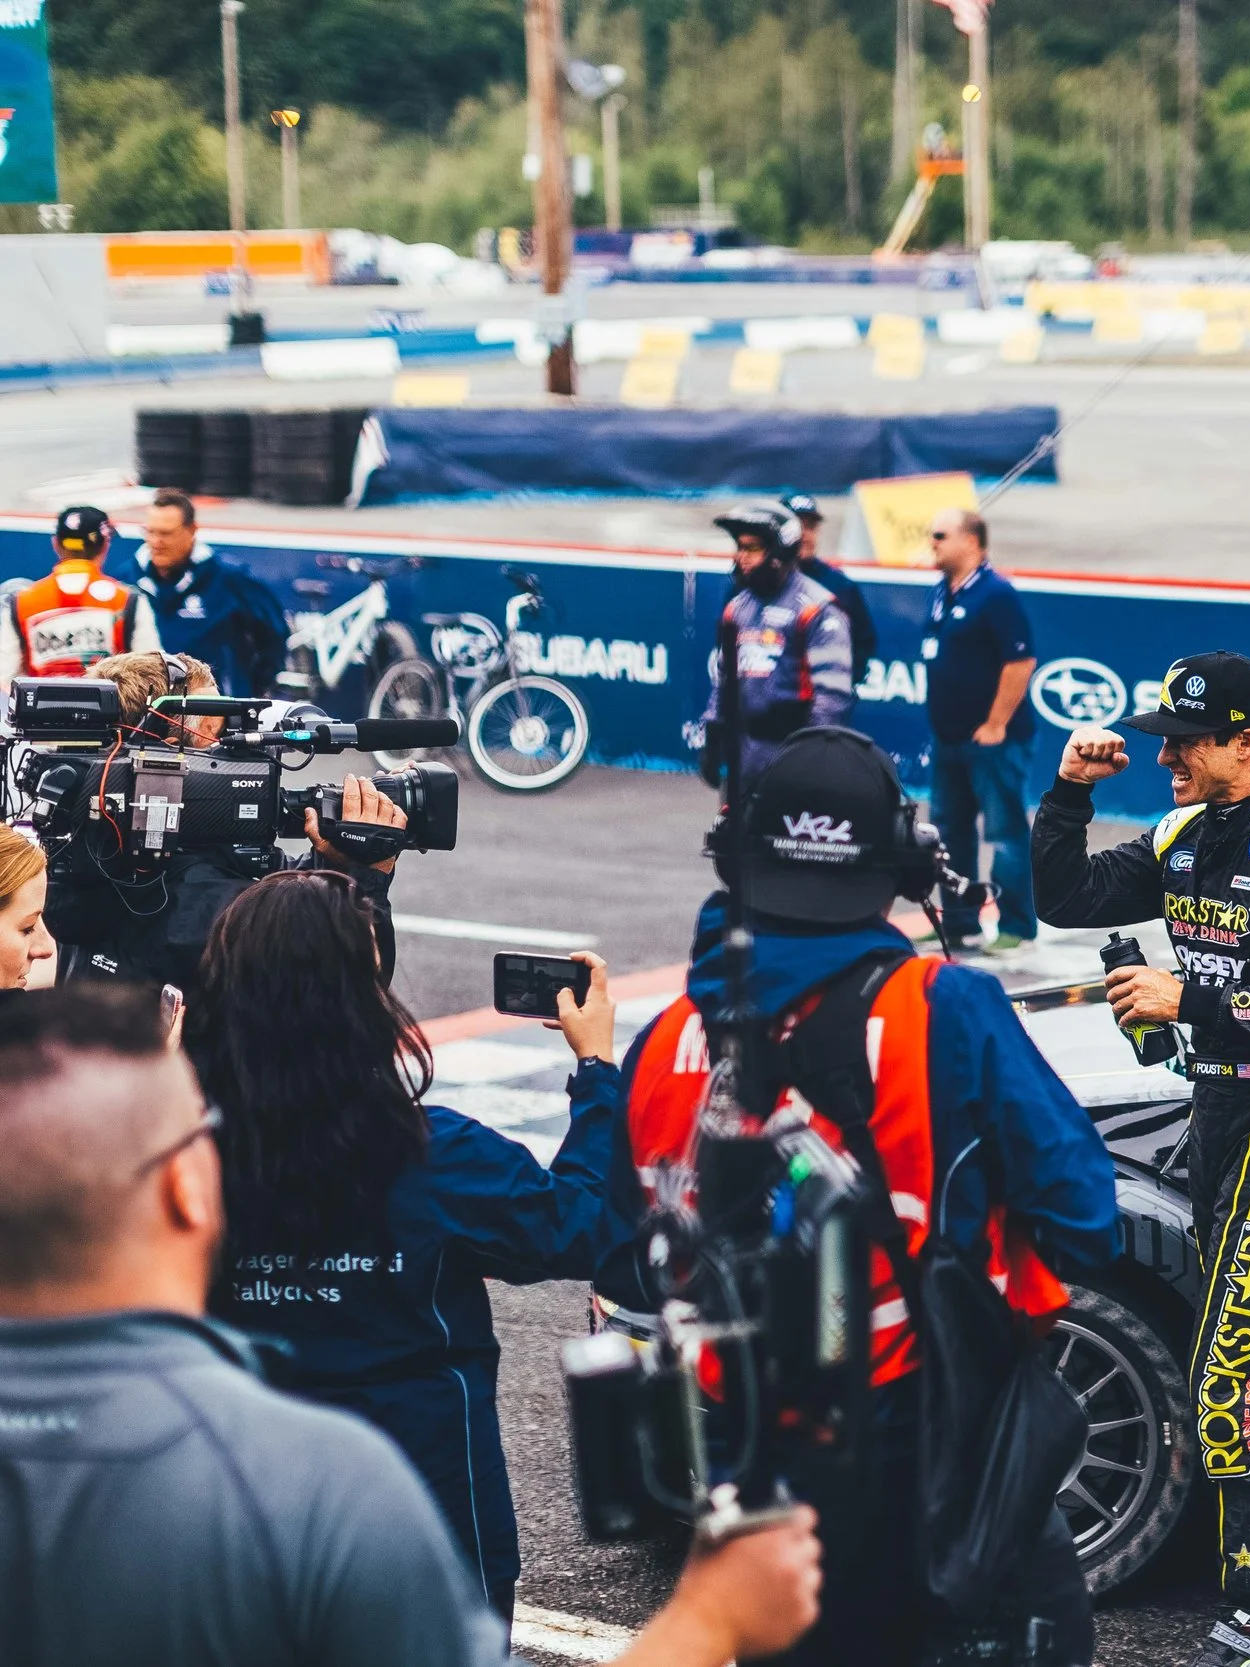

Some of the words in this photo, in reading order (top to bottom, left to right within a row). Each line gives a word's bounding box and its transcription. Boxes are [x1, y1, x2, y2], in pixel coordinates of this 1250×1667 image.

[506, 631, 668, 684] SUBARU
[231, 780, 264, 788] SONY
[340, 831, 366, 843] Canon
[1200, 925, 1239, 945] DRINK
